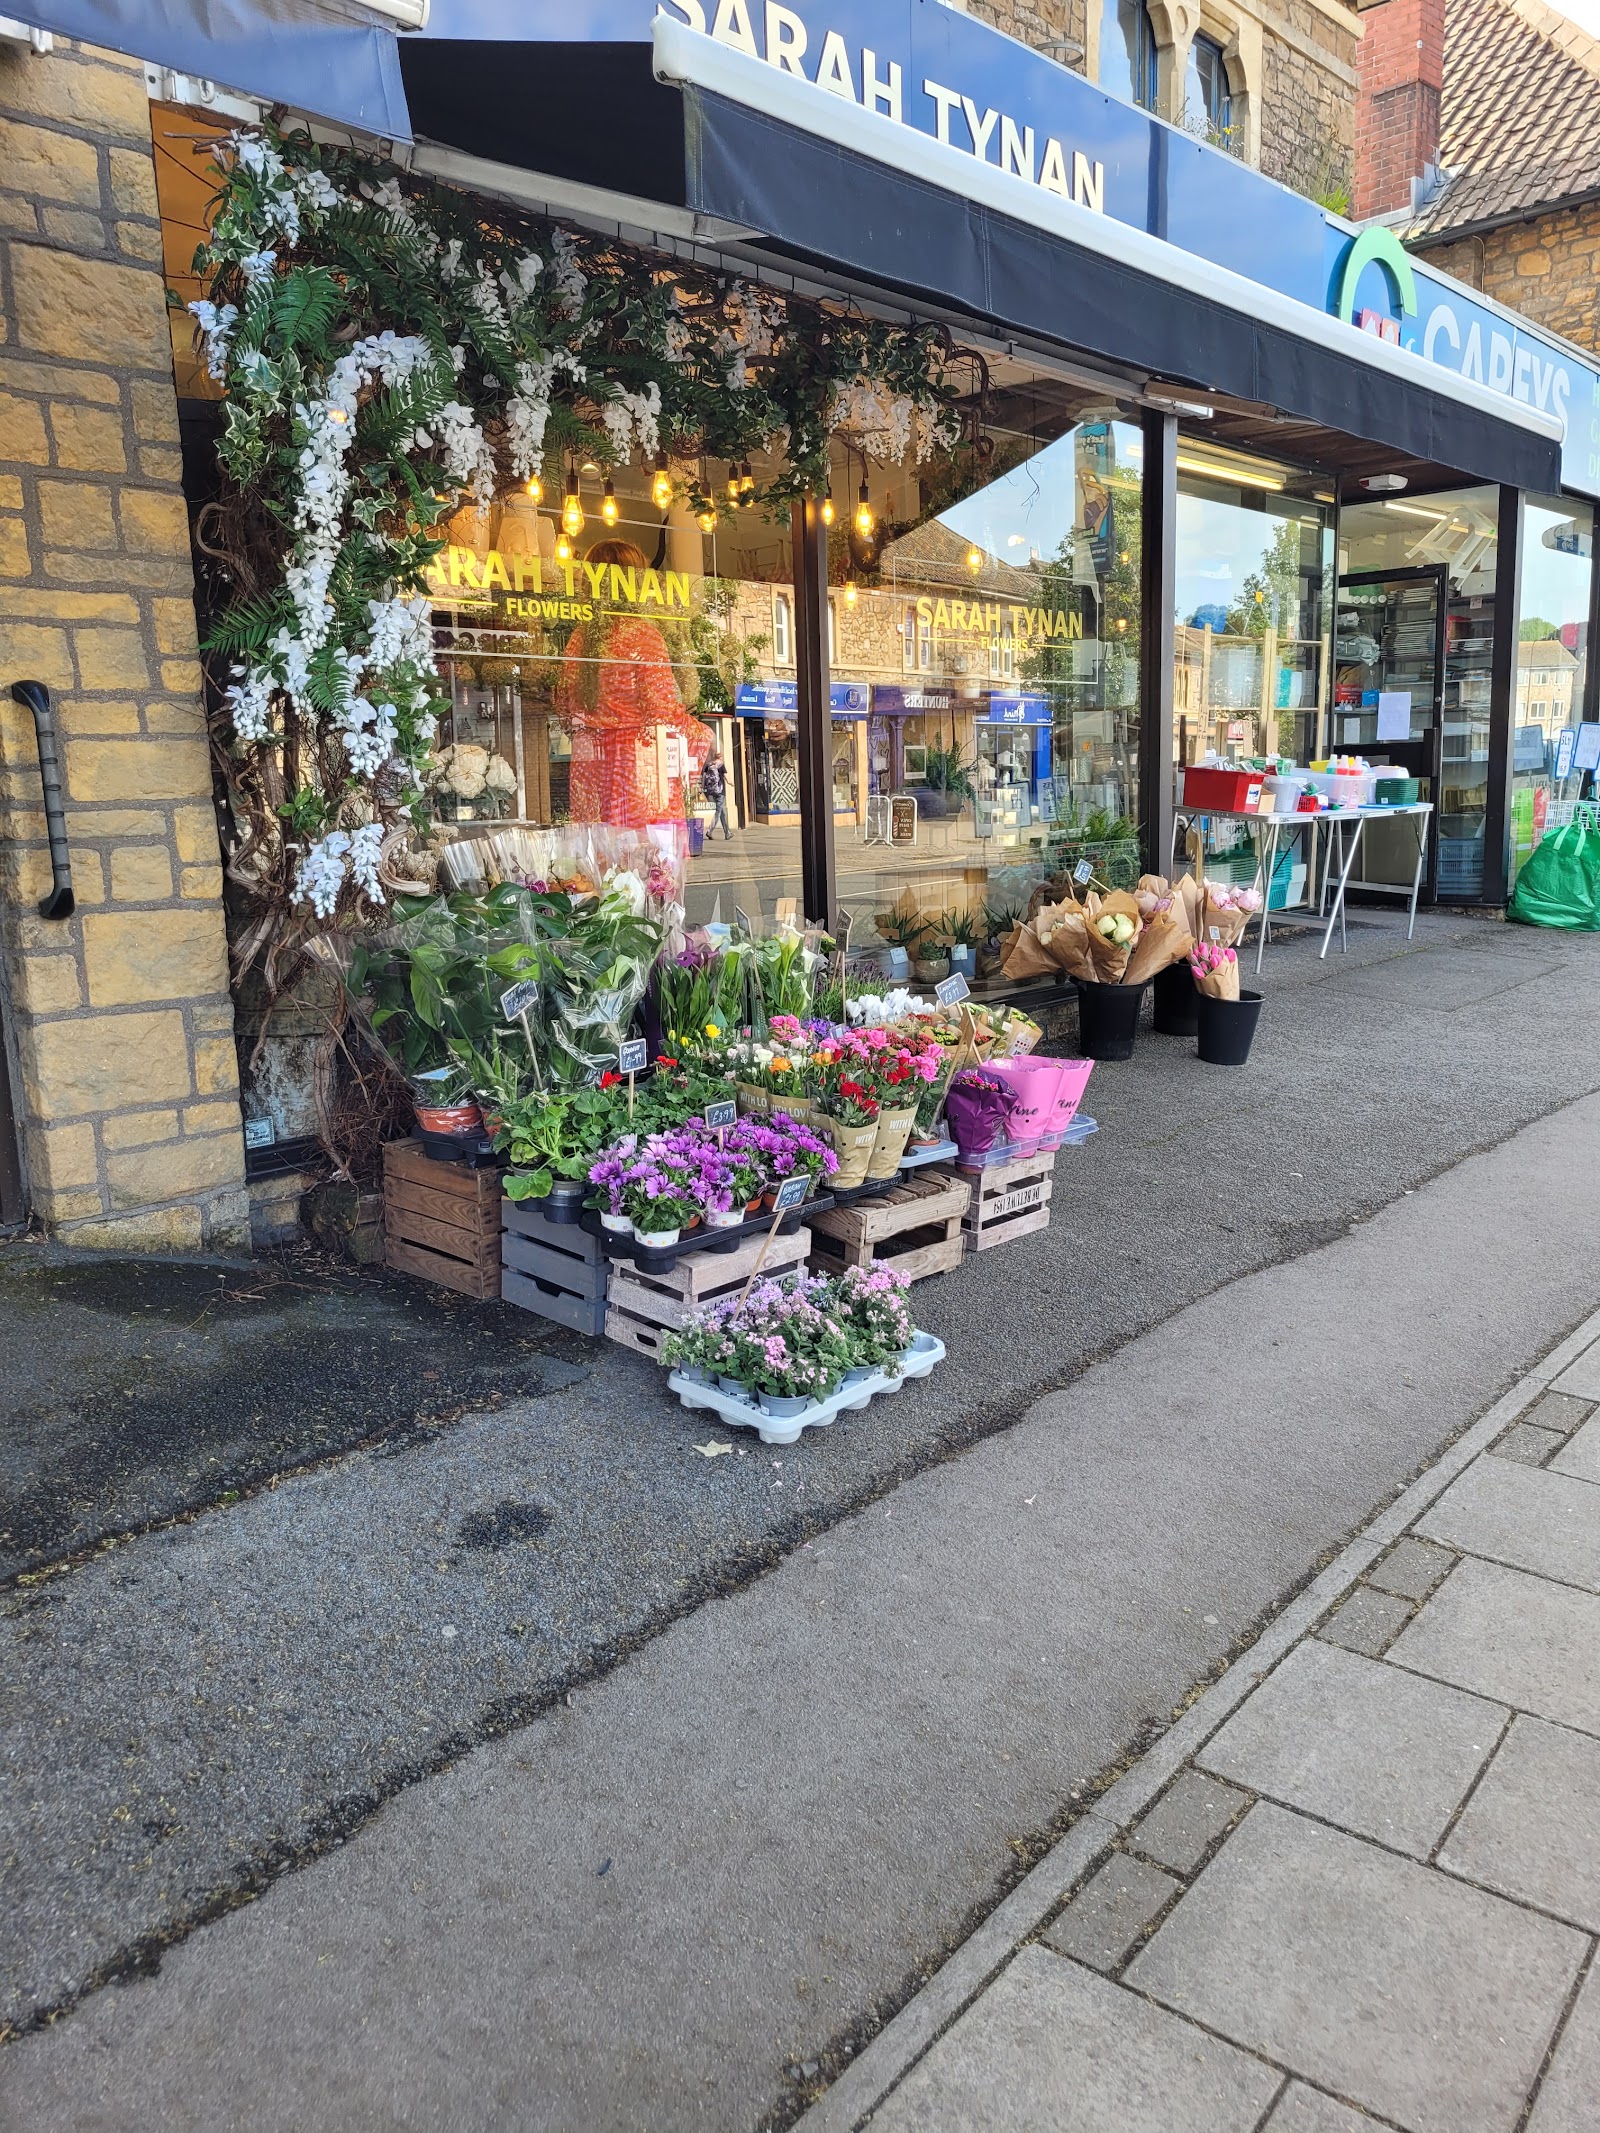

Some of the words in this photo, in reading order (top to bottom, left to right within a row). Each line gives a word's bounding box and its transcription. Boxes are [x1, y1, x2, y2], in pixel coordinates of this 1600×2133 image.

[656, 0, 902, 124] SARAH
[922, 78, 1105, 214] TYNAN
[424, 544, 542, 594] ARAH
[555, 559, 691, 608] TYNAN
[506, 597, 594, 622] FLOWERS
[916, 596, 1001, 633] SARAH
[1008, 605, 1083, 640] TYNAN
[980, 636, 1028, 653] FLOWERS
[889, 1117, 907, 1129] WITH
